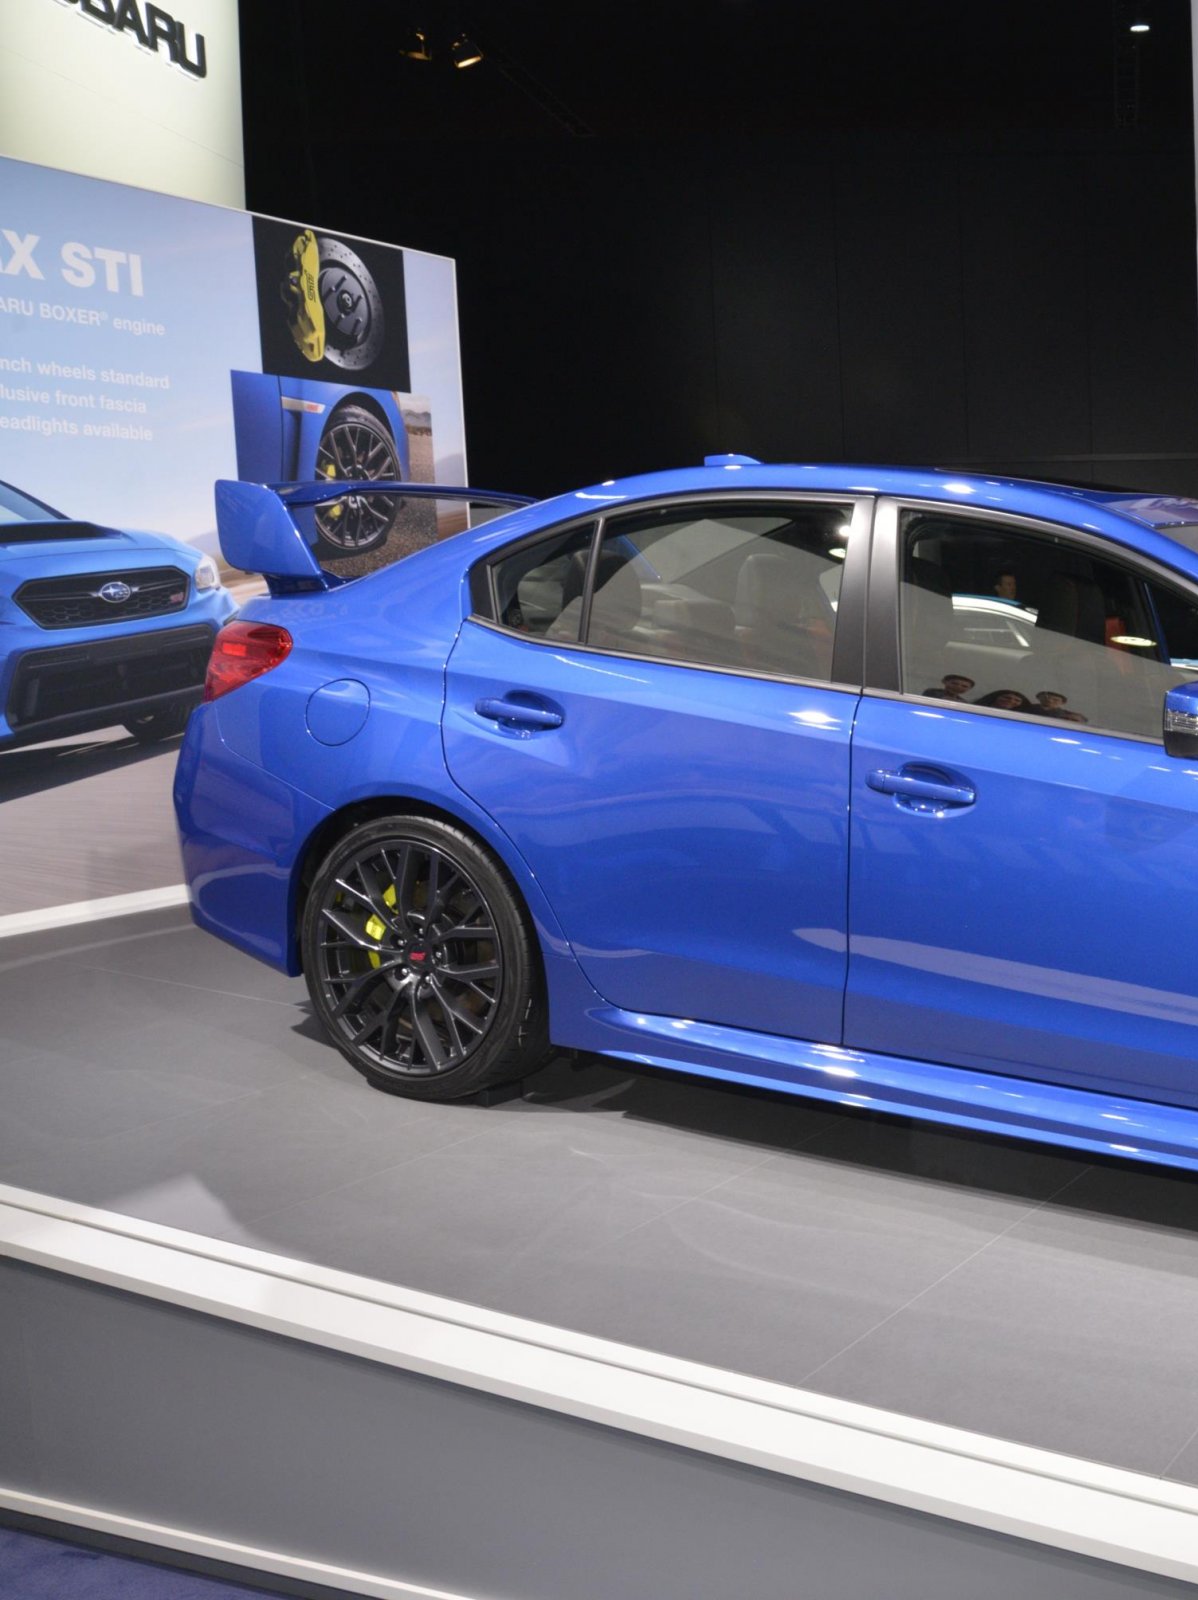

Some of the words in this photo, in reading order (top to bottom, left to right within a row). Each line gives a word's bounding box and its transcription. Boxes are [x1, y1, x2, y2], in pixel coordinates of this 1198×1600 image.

[64, 0, 207, 78] ARU
[0, 228, 46, 280] X
[61, 241, 144, 296] STI
[113, 317, 165, 336] engine
[0, 357, 32, 373] nch
[36, 361, 96, 381] wheels
[101, 369, 171, 389] standard
[0, 384, 50, 403] lusive
[55, 390, 96, 408] front
[100, 395, 147, 413] fascia
[0, 415, 78, 436] eadlights
[83, 421, 153, 440] available
